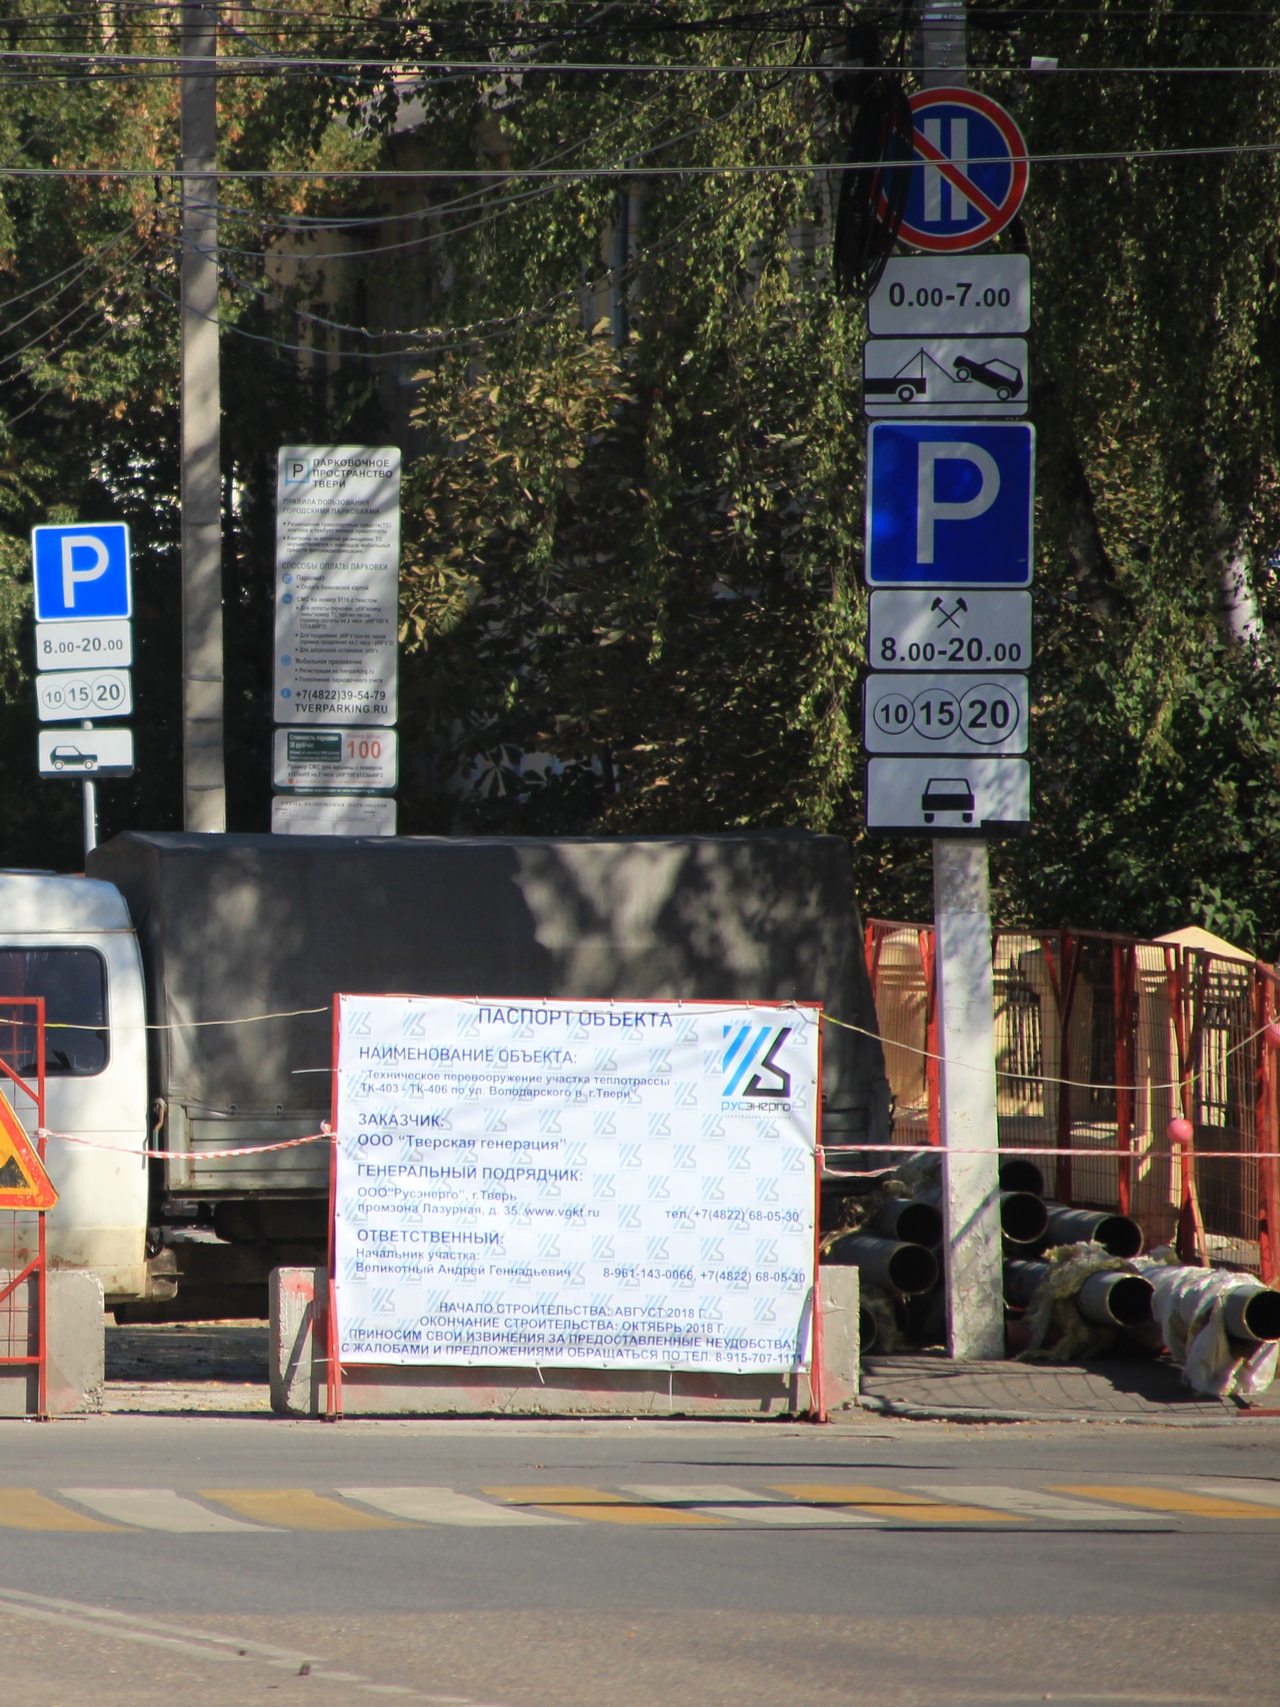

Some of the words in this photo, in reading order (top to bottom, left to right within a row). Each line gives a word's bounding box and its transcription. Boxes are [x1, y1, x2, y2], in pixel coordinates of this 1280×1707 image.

[888, 282, 1011, 307] 0.00-7.00
[292, 463, 304, 478] P
[313, 458, 390, 468] ПАРКОВОЧНОЕ
[313, 469, 393, 479] ПРОСТРАНСТВО
[313, 480, 346, 488] ТВЕРИ
[916, 442, 1001, 564] P
[61, 535, 109, 608] P
[43, 637, 124, 655] 8.00-20.00
[880, 636, 1022, 662] 8.00-20.00
[45, 690, 62, 704] 10
[68, 687, 89, 703] 15
[96, 683, 120, 702] 20
[295, 689, 387, 702] +7(4822)39-54-79
[295, 703, 388, 714] TVERPARKING.RU
[879, 703, 909, 725] 10
[918, 701, 955, 727] 15
[967, 699, 1010, 729] 20
[346, 741, 382, 759] 100
[478, 1007, 573, 1026] ПАСПОРТ
[578, 1010, 673, 1028] ОБЪЕКТА
[359, 1046, 495, 1063] НАИМЕНОВАНИЕ
[499, 1049, 577, 1064] ОБЪЕКТА:
[443, 1073, 543, 1085] перевооружение
[545, 1075, 591, 1085] участка
[594, 1076, 671, 1087] теплотрассы
[361, 1083, 399, 1094] ТК-403
[410, 1084, 448, 1095] ТК-406
[451, 1087, 465, 1095] по
[468, 1087, 484, 1097] ул.
[490, 1086, 572, 1099] Володарского
[721, 1101, 791, 1114] русэнерго
[358, 1113, 444, 1127] ЗАКАЗЧИК:
[357, 1134, 393, 1147] ООО
[357, 1164, 478, 1180] ГЕНЕРАЛЬНЫЙ
[482, 1167, 583, 1183] ПОДРЯДЧИК:
[472, 1190, 517, 1203] г.Тверь
[357, 1203, 419, 1215] промзона
[422, 1203, 485, 1217] Лазурная,
[488, 1206, 500, 1216] д.
[524, 1208, 600, 1220] www.vgkt.ru
[694, 1209, 746, 1223] +7(4822)
[749, 1211, 800, 1223] 68-05-30
[357, 1229, 504, 1245] ОТВЕТСТВЕННЫЙ:
[356, 1248, 424, 1260] Начальник
[428, 1251, 480, 1262] участка:
[355, 1262, 434, 1274] Великотный
[438, 1264, 485, 1277] Андрей
[489, 1265, 571, 1278] Геннадьевич
[603, 1267, 697, 1281] 8-961-143-0066,
[700, 1270, 752, 1284] +7(4822)
[755, 1271, 806, 1284] 68-05-30
[439, 1302, 493, 1313] НАЧАЛО
[496, 1303, 611, 1317] СТРОИТЕЛЬСТВА:
[614, 1306, 664, 1318] АВГУСТ
[667, 1308, 695, 1319] 2018
[699, 1308, 707, 1319] Г.
[419, 1316, 500, 1328] ОКОНЧАНИЕ
[504, 1318, 618, 1332] СТРОИТЕЛЬСТВА:
[622, 1321, 682, 1334] ОКТЯБРЬ
[685, 1323, 713, 1334] 2018
[717, 1323, 726, 1334] Г.
[349, 1329, 422, 1341] ПРИНОСИМ
[426, 1330, 463, 1342] СВОИ
[466, 1331, 546, 1343] ИЗВИНЕНИЯ
[548, 1333, 565, 1344] ЗА
[569, 1333, 702, 1348] ПРЕДОСТАВЛЕННЫЕ
[341, 1343, 350, 1353] С
[353, 1343, 429, 1355] ЖАЛОБАМИ
[433, 1345, 442, 1355] И
[446, 1345, 564, 1358] ПРЕДЛОЖЕНИЯМИ
[567, 1347, 658, 1362] ОБРАЩАТЬСЯ
[662, 1350, 681, 1361] ПО
[684, 1351, 712, 1363] ТЕЛ.
[715, 1351, 803, 1364] 8-915-707-1111
